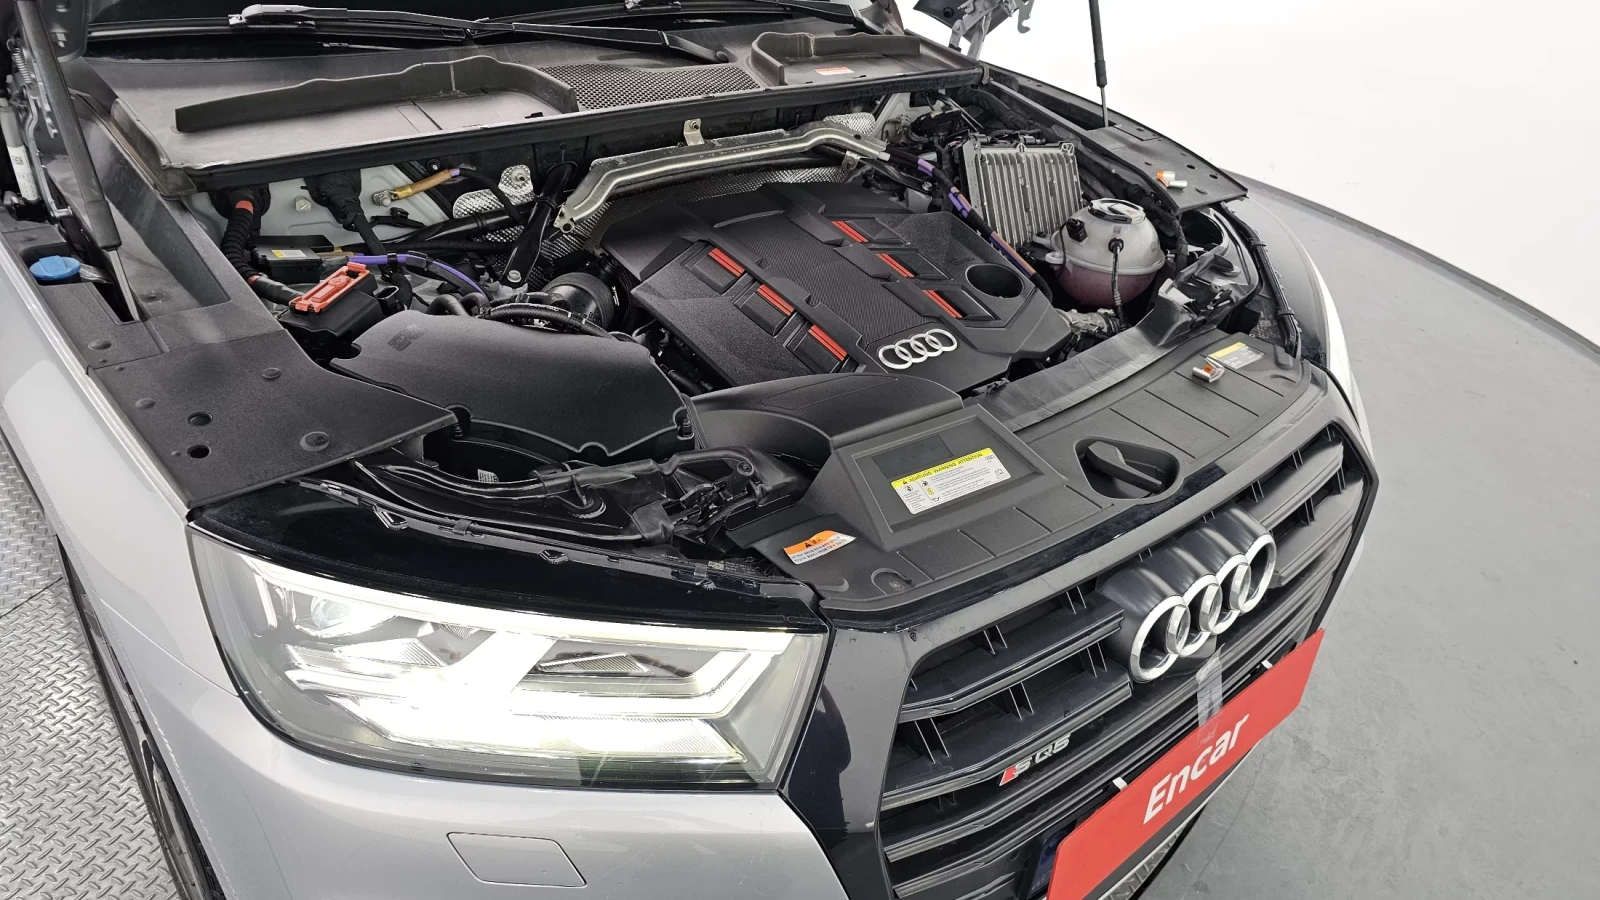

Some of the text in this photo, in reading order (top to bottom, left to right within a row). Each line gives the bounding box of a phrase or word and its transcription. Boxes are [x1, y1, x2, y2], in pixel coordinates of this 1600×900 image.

[909, 471, 932, 482] ACHTUNG
[934, 462, 957, 473] WARNING
[958, 453, 983, 465] ATTENTION
[1012, 733, 1071, 778] SQ5
[1143, 713, 1250, 825] Encar
